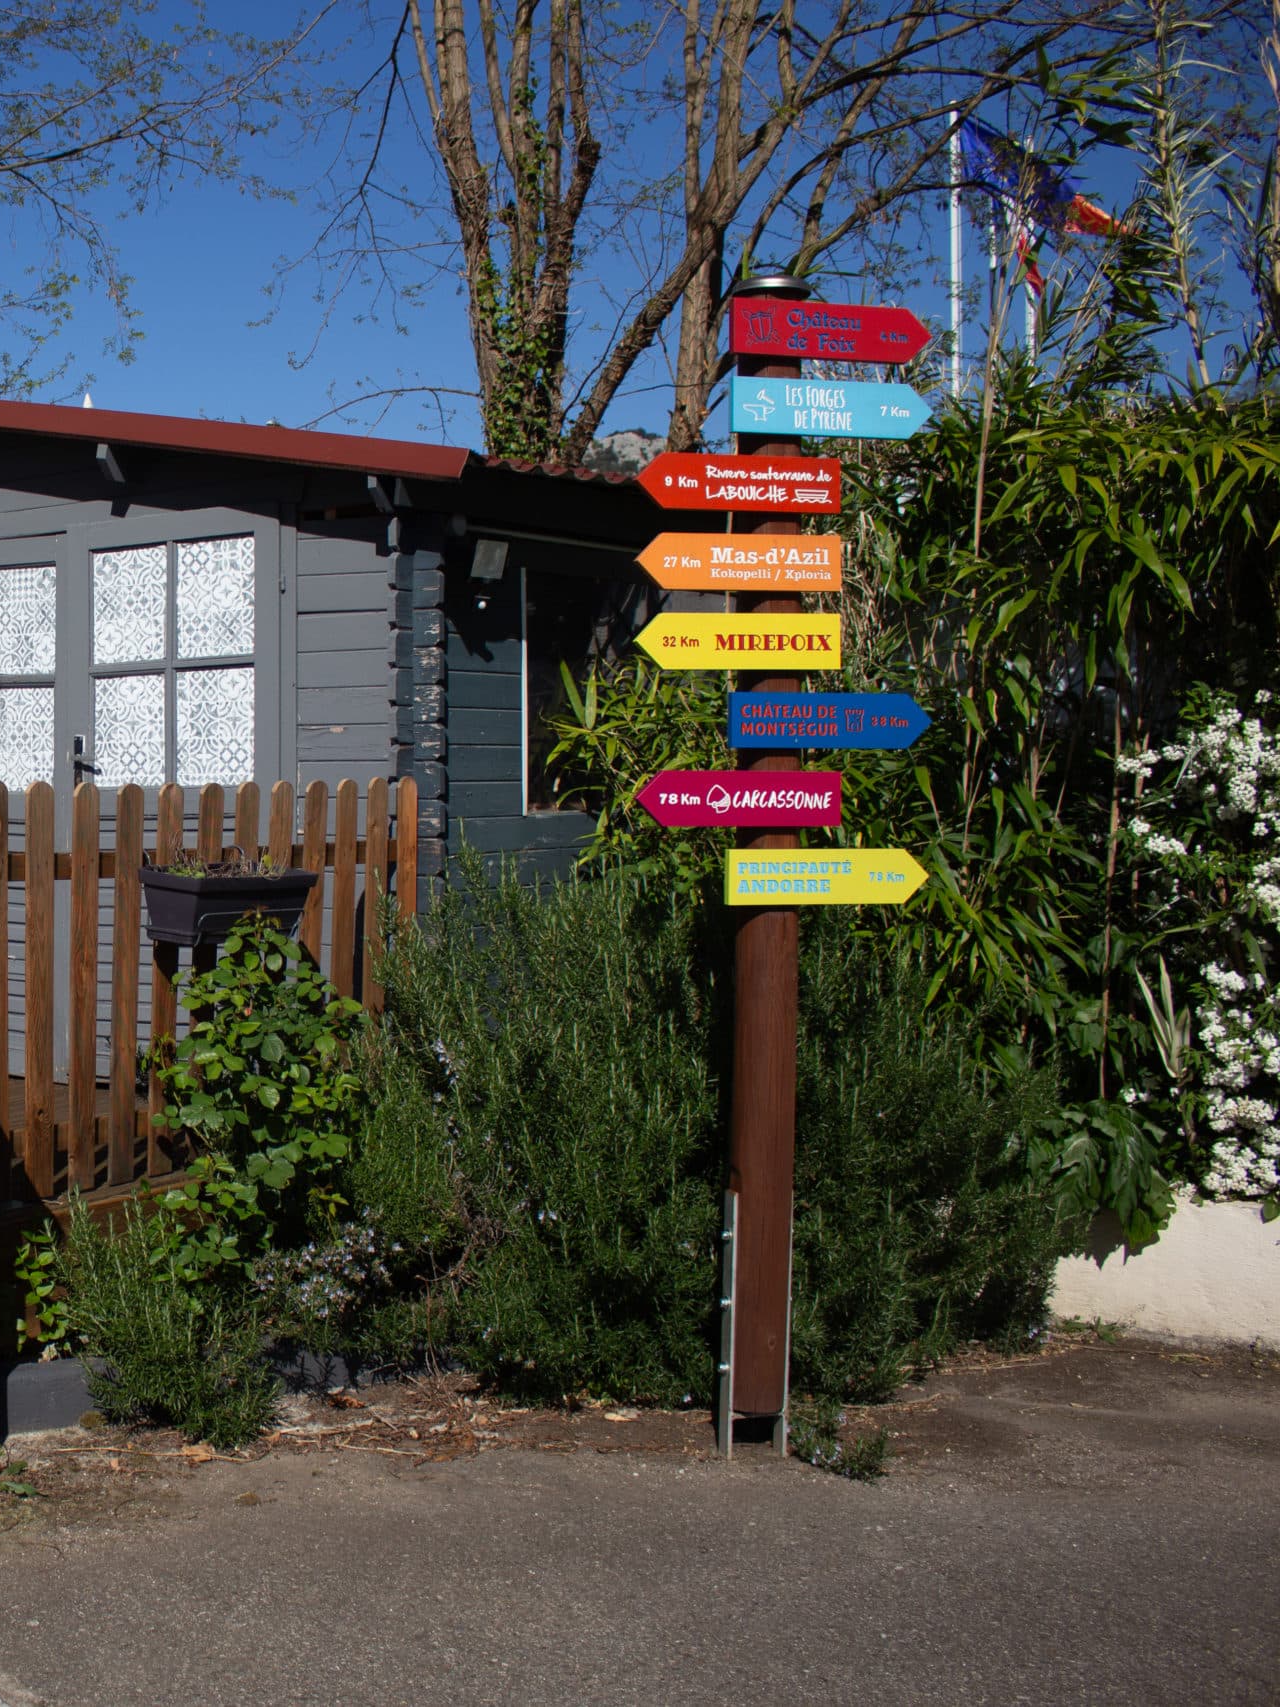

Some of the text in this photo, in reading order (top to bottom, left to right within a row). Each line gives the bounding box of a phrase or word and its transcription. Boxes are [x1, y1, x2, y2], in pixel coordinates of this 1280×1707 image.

[787, 308, 862, 332] Château
[787, 333, 857, 353] de Foix
[889, 332, 908, 344] Km
[806, 385, 846, 411] FORGES
[880, 405, 910, 418] 7 Km
[794, 411, 810, 430] DE
[665, 476, 698, 488] 9 Km
[750, 466, 815, 482] souterraine
[816, 469, 832, 482] de
[705, 485, 789, 503] LABOUICHE
[663, 556, 701, 568] 27 Km
[710, 547, 830, 566] Mas-d'Azil
[710, 568, 771, 581] Kokopelli
[784, 569, 832, 582] Xploria
[662, 636, 700, 648] 32 Km
[715, 634, 832, 651] MIREPOIX
[740, 701, 837, 719] CHÂTEAU DE
[740, 720, 838, 737] MONTSÉGUR
[890, 716, 909, 728] Km
[659, 793, 701, 806] 78 Km
[732, 790, 833, 810] CARCASSONNE
[737, 858, 853, 875] PRINCIPAUTÉ
[886, 871, 905, 882] Km
[737, 879, 832, 894] ANDORRE
